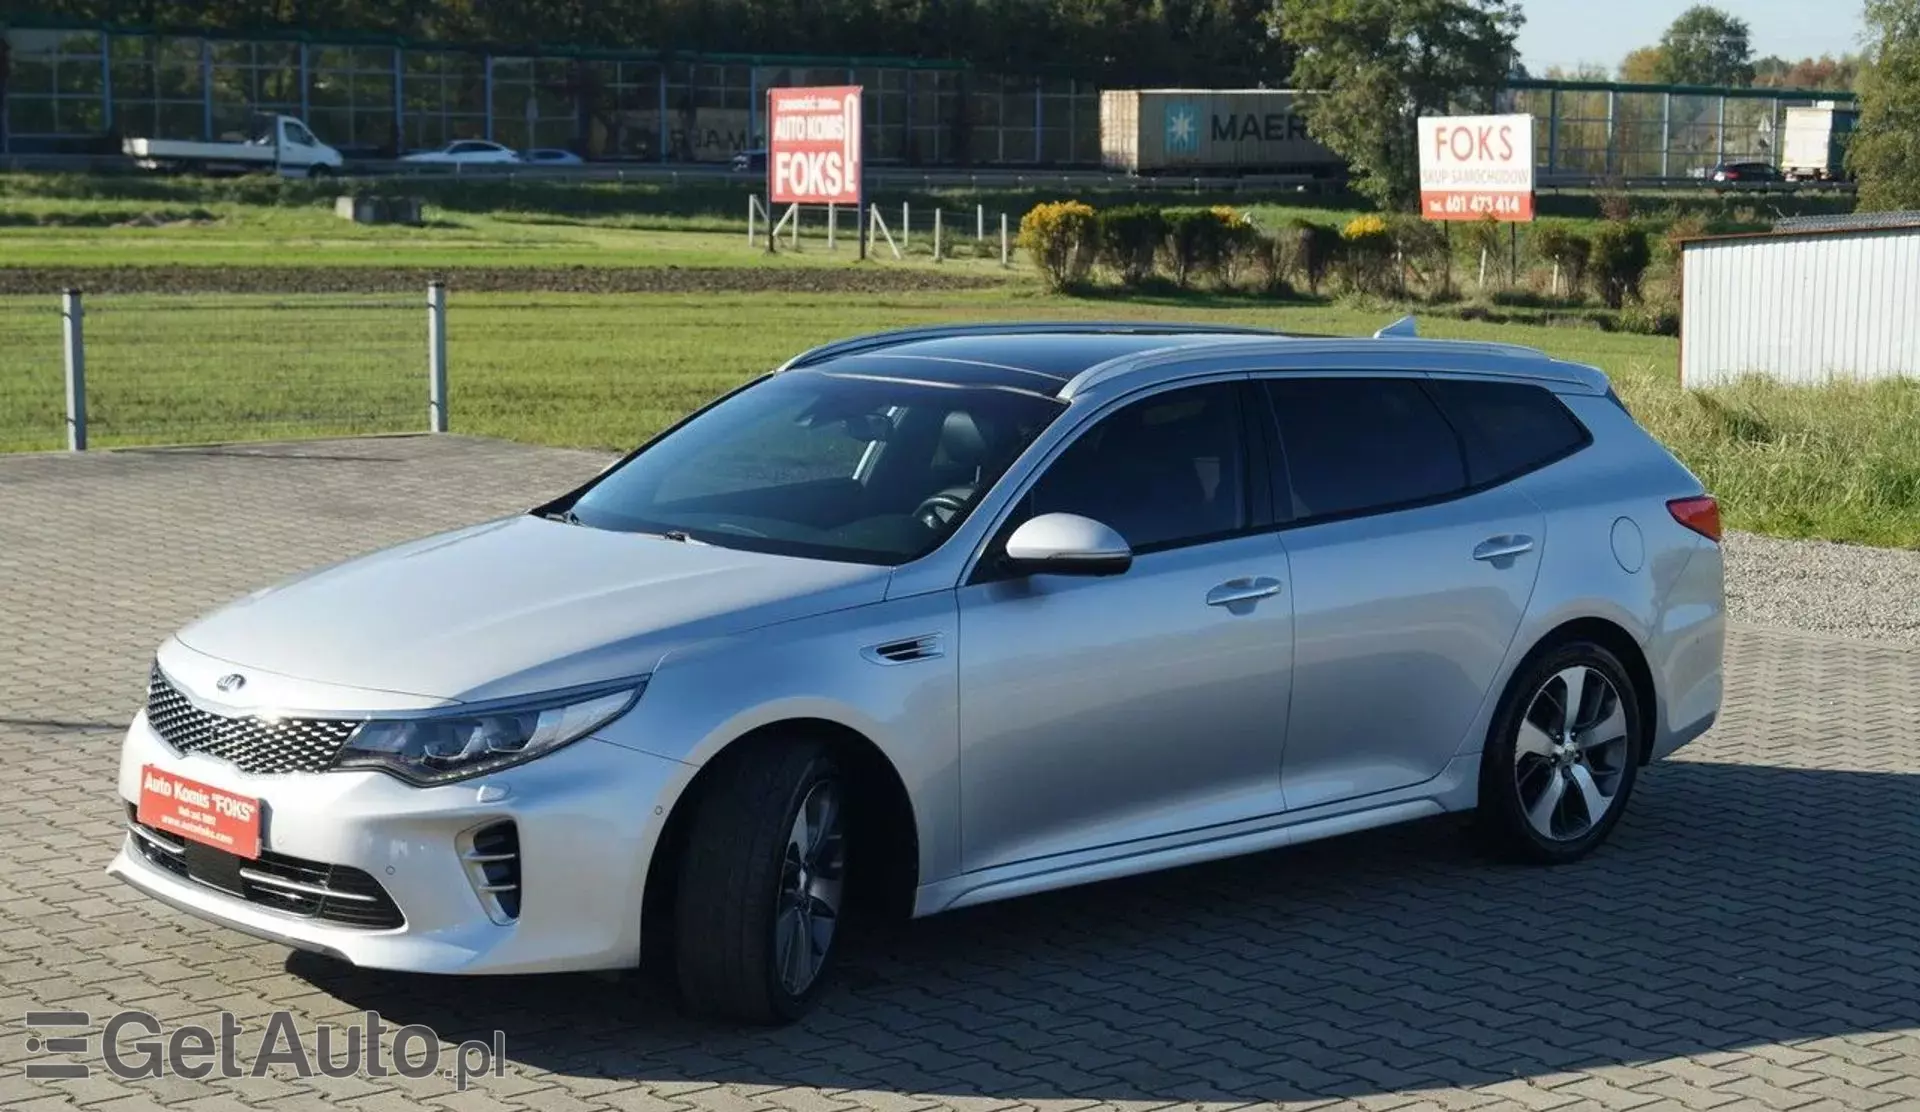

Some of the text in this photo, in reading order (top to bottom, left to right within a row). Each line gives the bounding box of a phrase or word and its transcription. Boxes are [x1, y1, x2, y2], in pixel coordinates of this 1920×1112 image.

[774, 116, 806, 140] AUTO
[1211, 114, 1307, 141] MAER
[1435, 125, 1513, 161] FOKS
[775, 151, 843, 196] FOKS
[1446, 195, 1466, 212] 601
[1495, 195, 1520, 213] 414
[144, 772, 172, 797] Auto
[174, 781, 210, 809] Komis
[211, 793, 256, 822] "FOKS"
